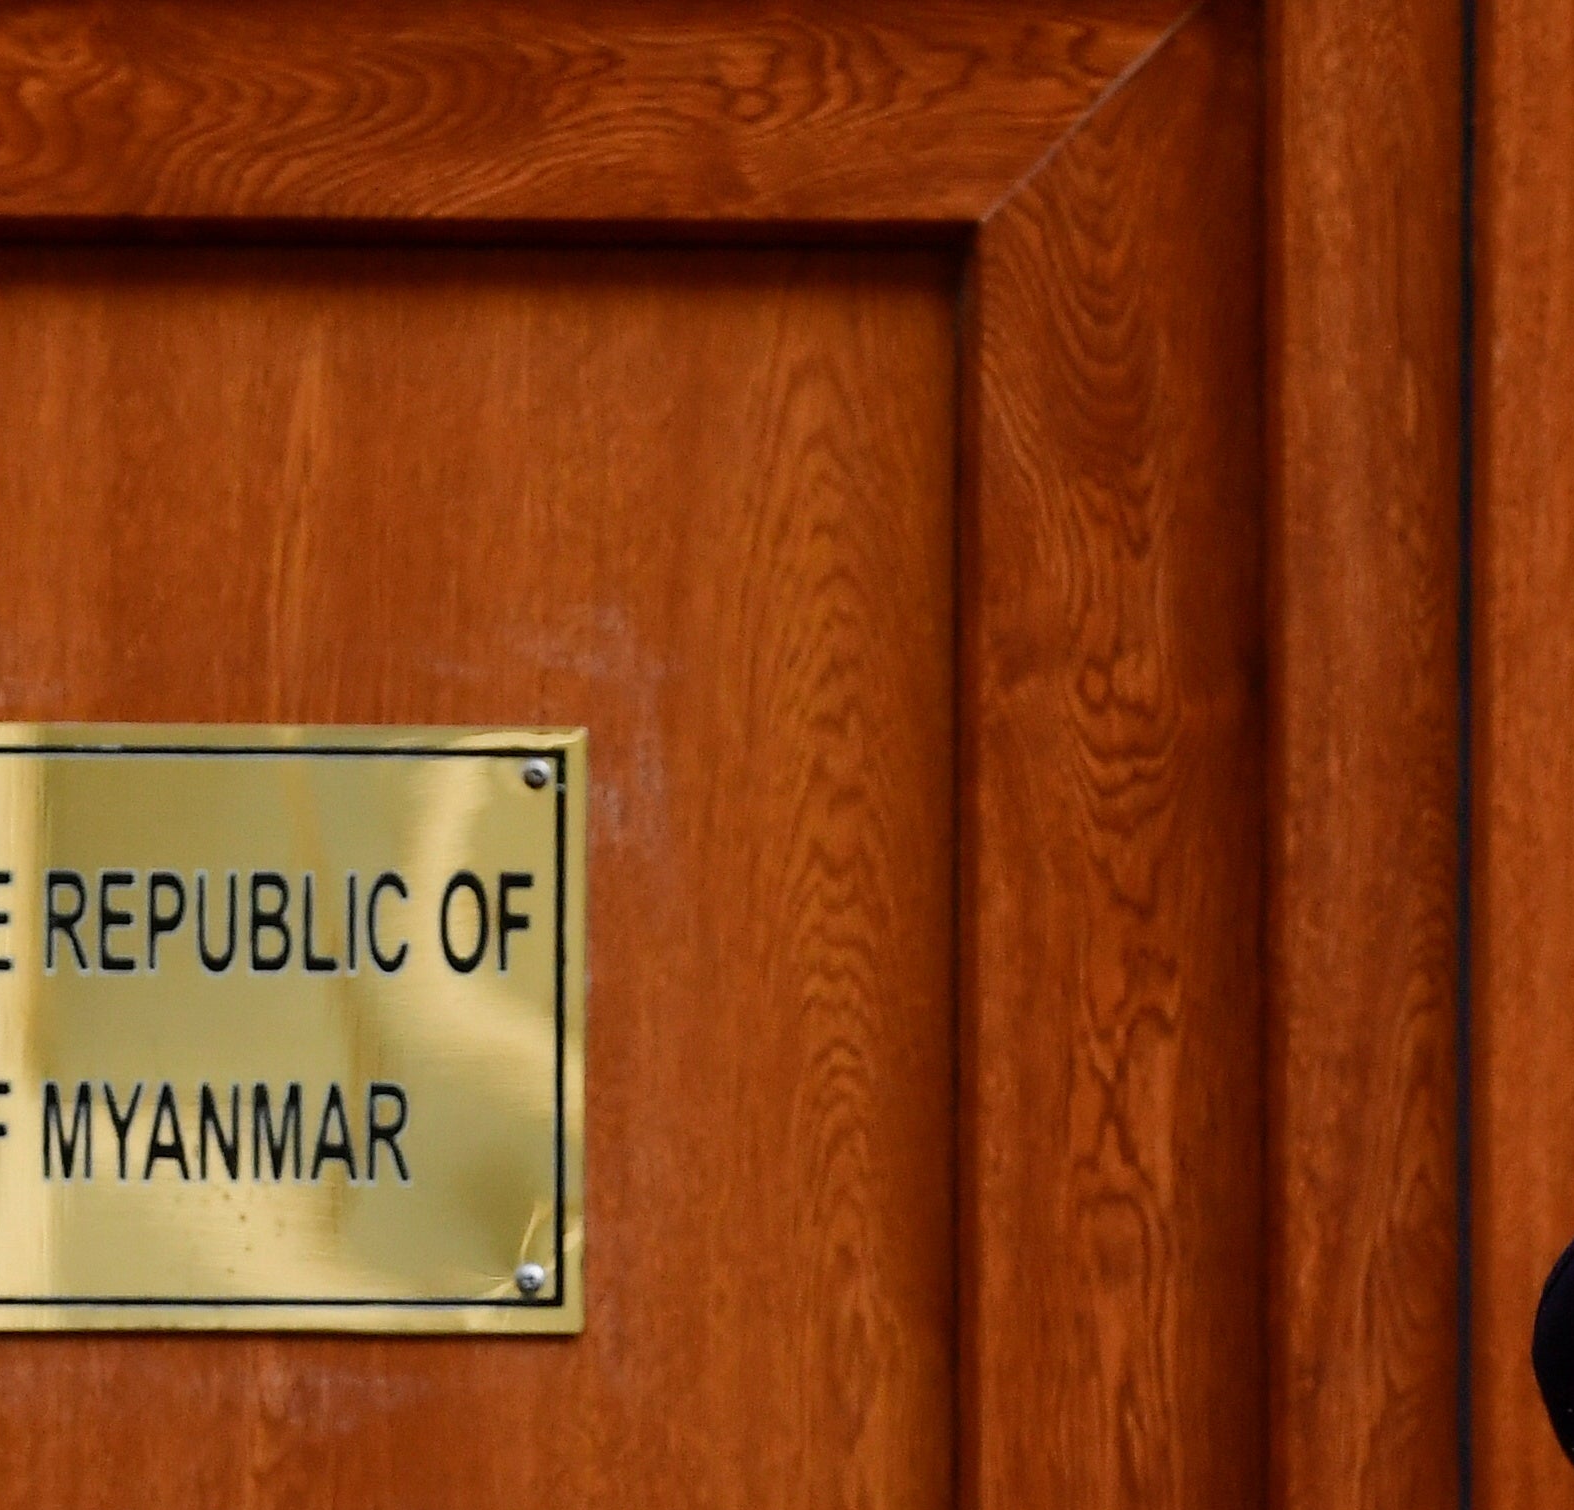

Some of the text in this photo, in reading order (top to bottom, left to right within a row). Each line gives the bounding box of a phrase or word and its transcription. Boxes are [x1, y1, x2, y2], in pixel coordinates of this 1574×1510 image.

[45, 870, 411, 977] REPUBLIC
[439, 870, 535, 977] OF
[42, 1079, 411, 1187] MYANMAR
